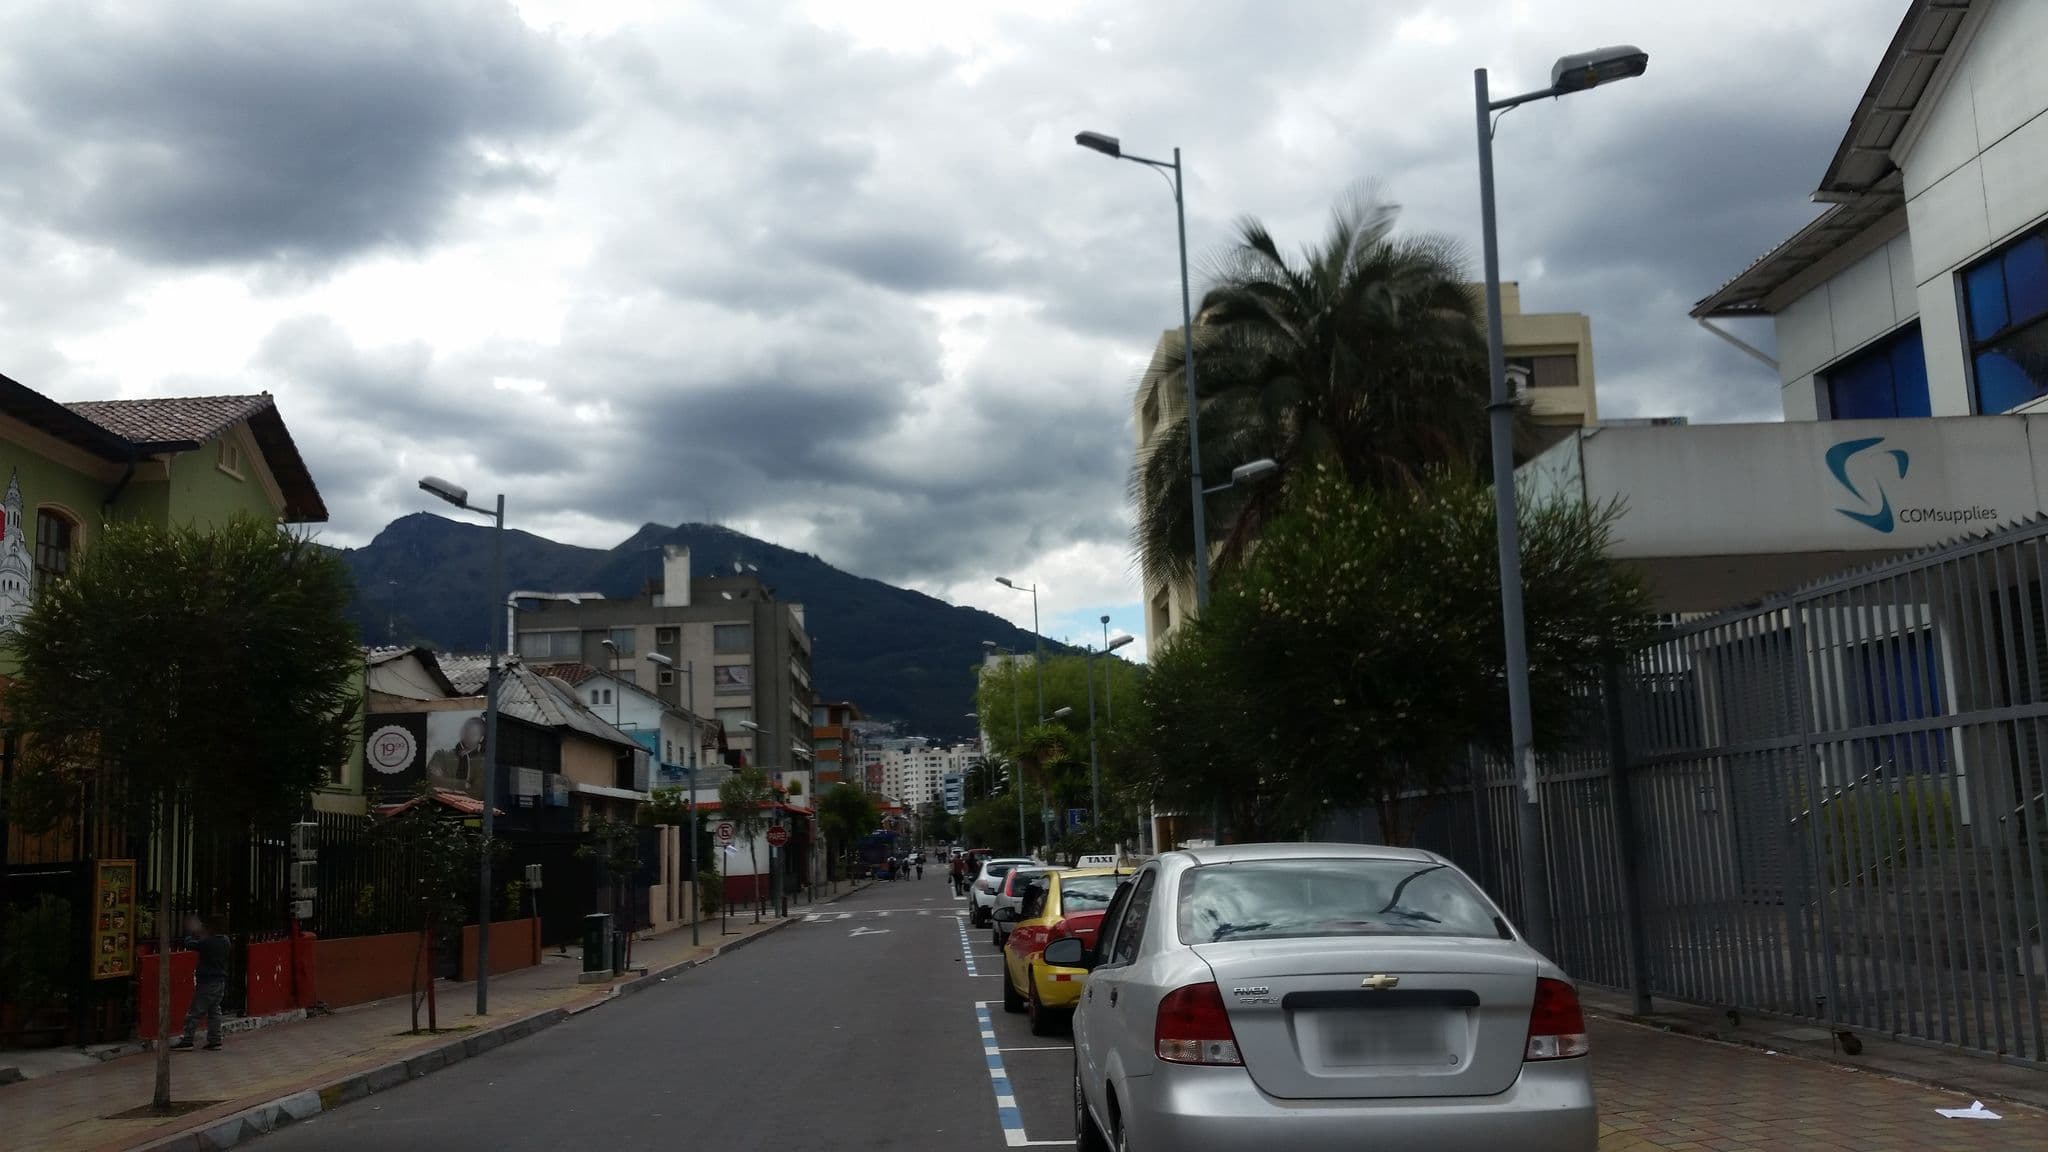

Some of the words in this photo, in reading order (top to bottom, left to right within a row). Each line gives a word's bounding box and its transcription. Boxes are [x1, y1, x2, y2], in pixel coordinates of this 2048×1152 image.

[1899, 506, 1998, 524] COMsupplies
[1087, 856, 1113, 864] TAXI
[1233, 986, 1269, 996] AVEO
